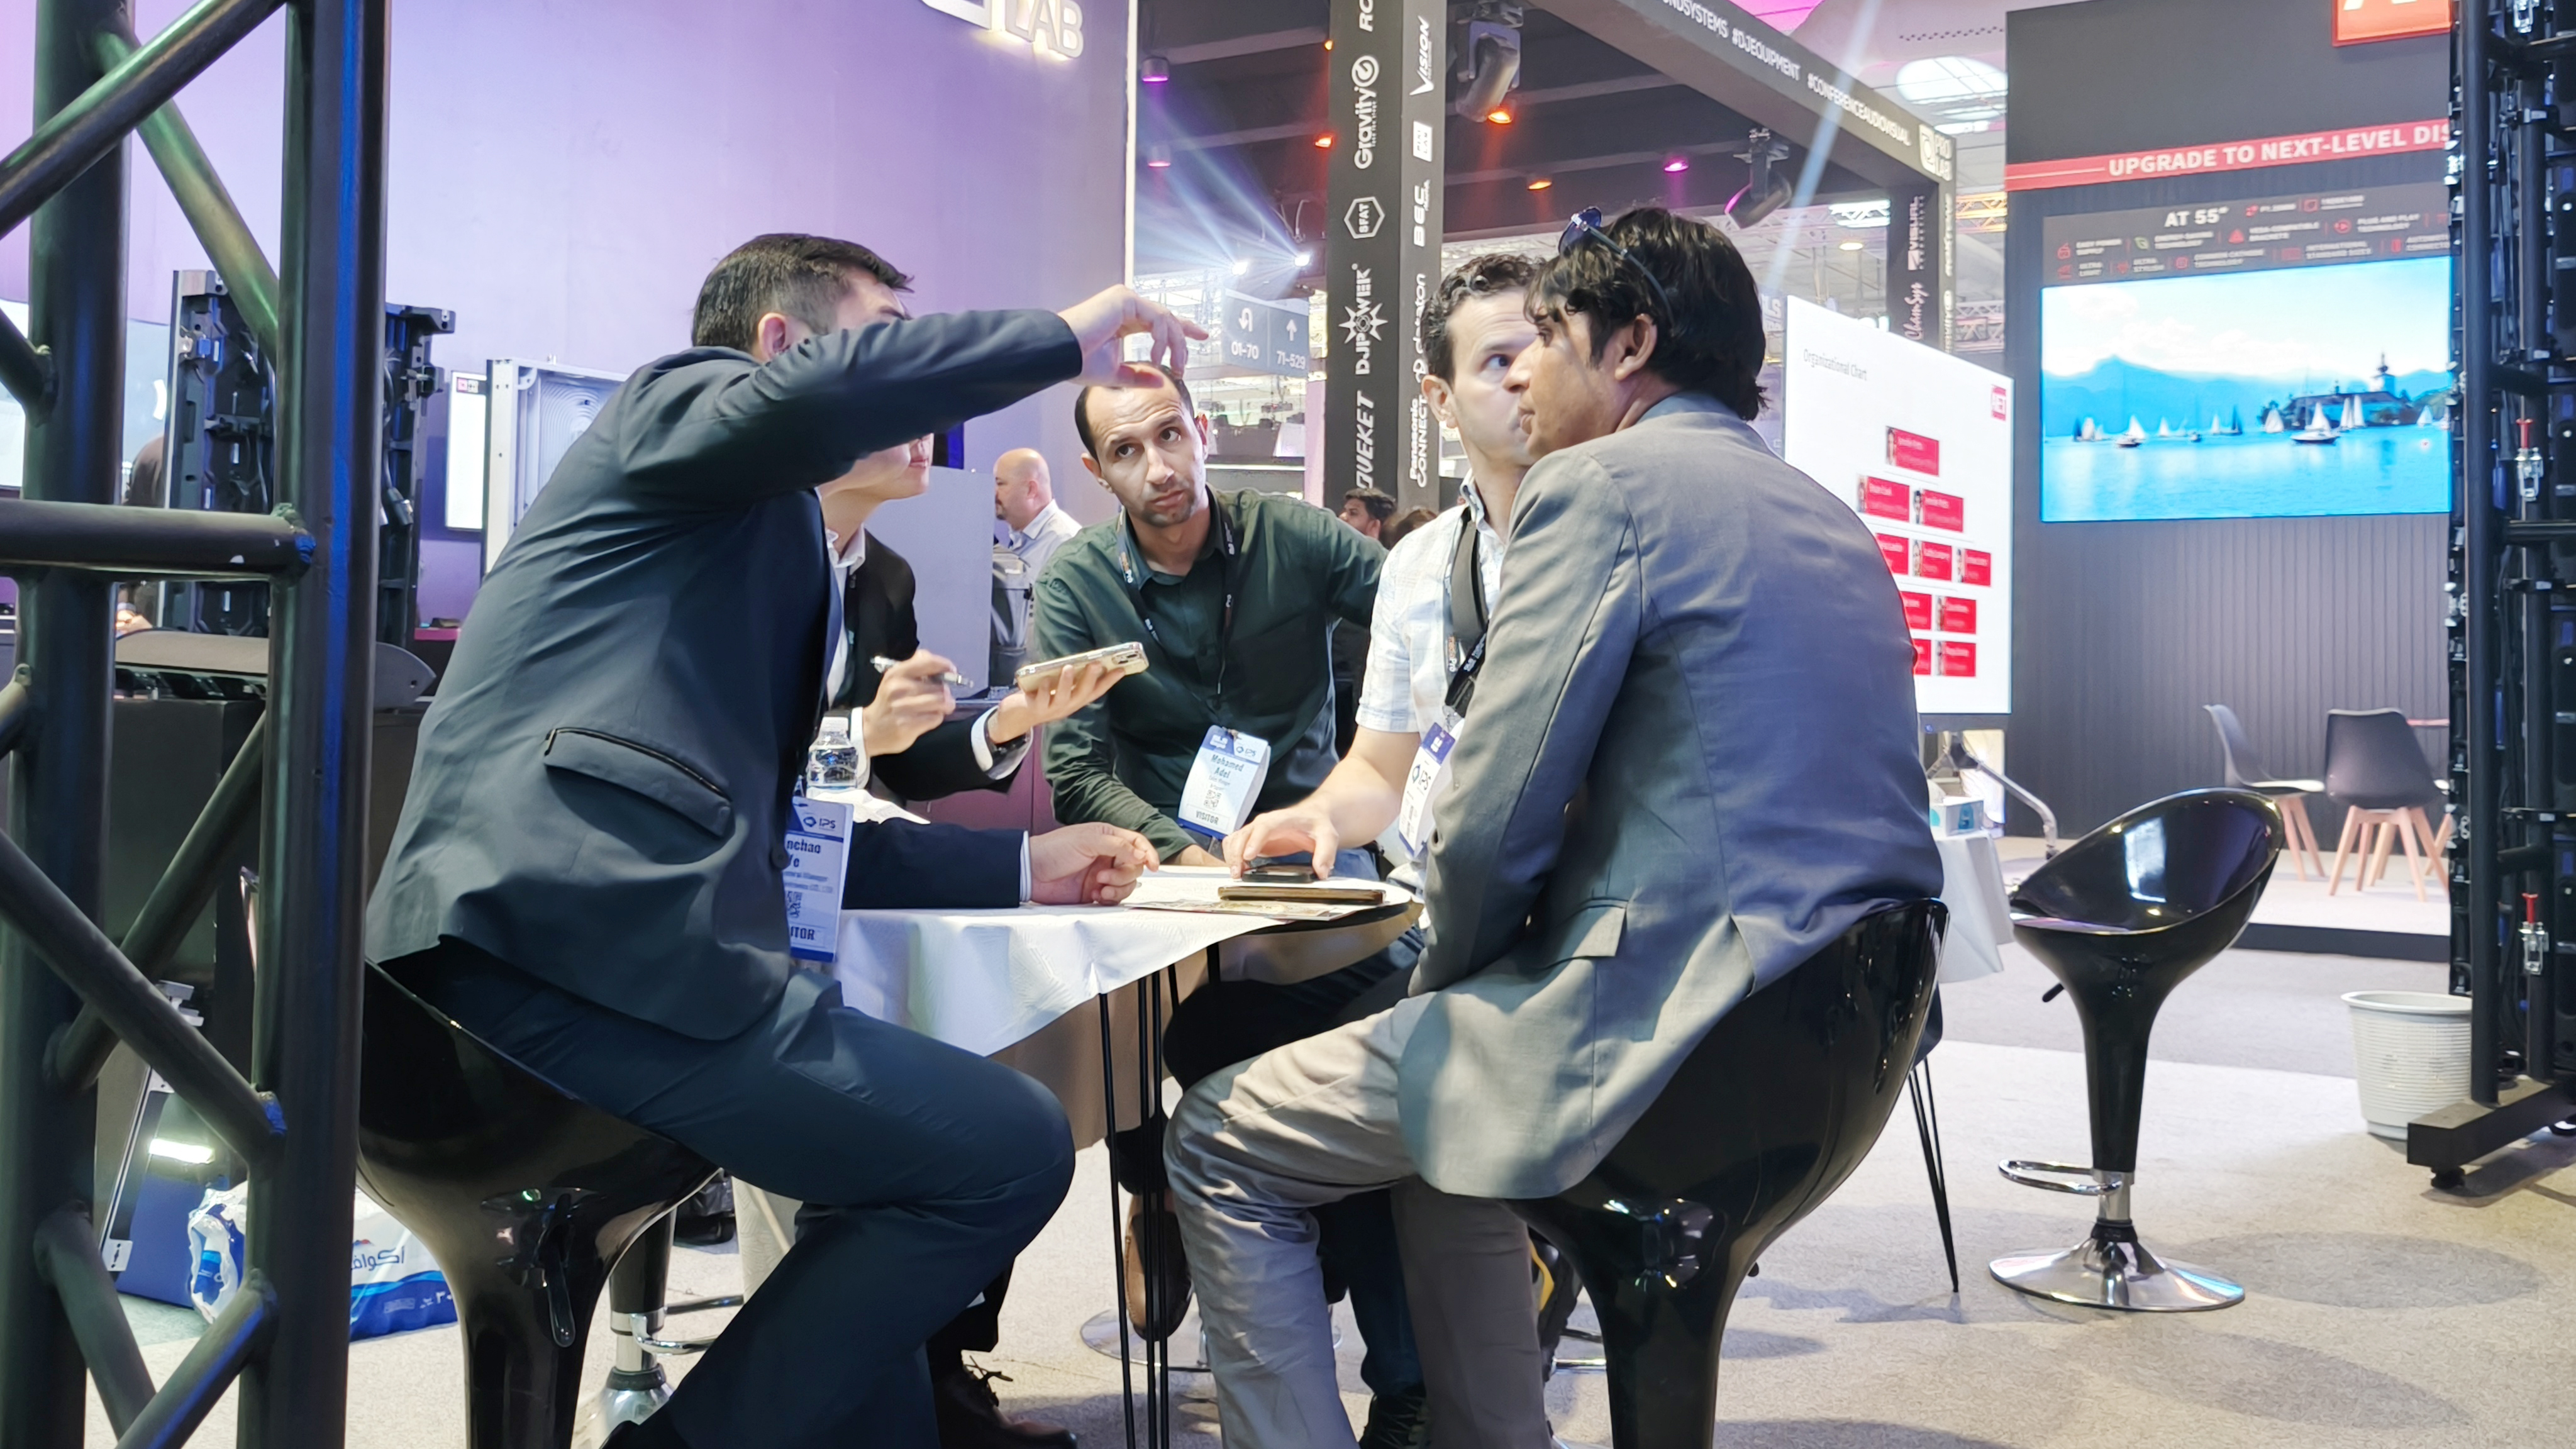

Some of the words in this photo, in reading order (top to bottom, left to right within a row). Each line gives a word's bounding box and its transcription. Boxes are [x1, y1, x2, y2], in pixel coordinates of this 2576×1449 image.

[1004, 0, 1084, 58] LAB
[1409, 15, 1434, 96] VISION
[1732, 28, 1801, 80] #DJEQUIPMENT
[1354, 86, 1377, 169] Gravity
[2109, 149, 2217, 176] UPGRADE
[2223, 145, 2255, 165] TO
[2261, 128, 2407, 160] NEXT-LEVEL
[2164, 211, 2190, 228] AT
[1231, 341, 1259, 359] 01-70
[1276, 350, 1306, 369] 71-529
[1803, 349, 1850, 374] Organizational
[1850, 363, 1867, 381] Chart
[1410, 398, 1419, 480] Panasonic
[1417, 394, 1428, 488] CONNECT
[1211, 754, 1245, 772] Mohamed
[1214, 767, 1231, 779] Adel
[819, 818, 836, 829] IPS
[1196, 810, 1219, 825] VISITOR
